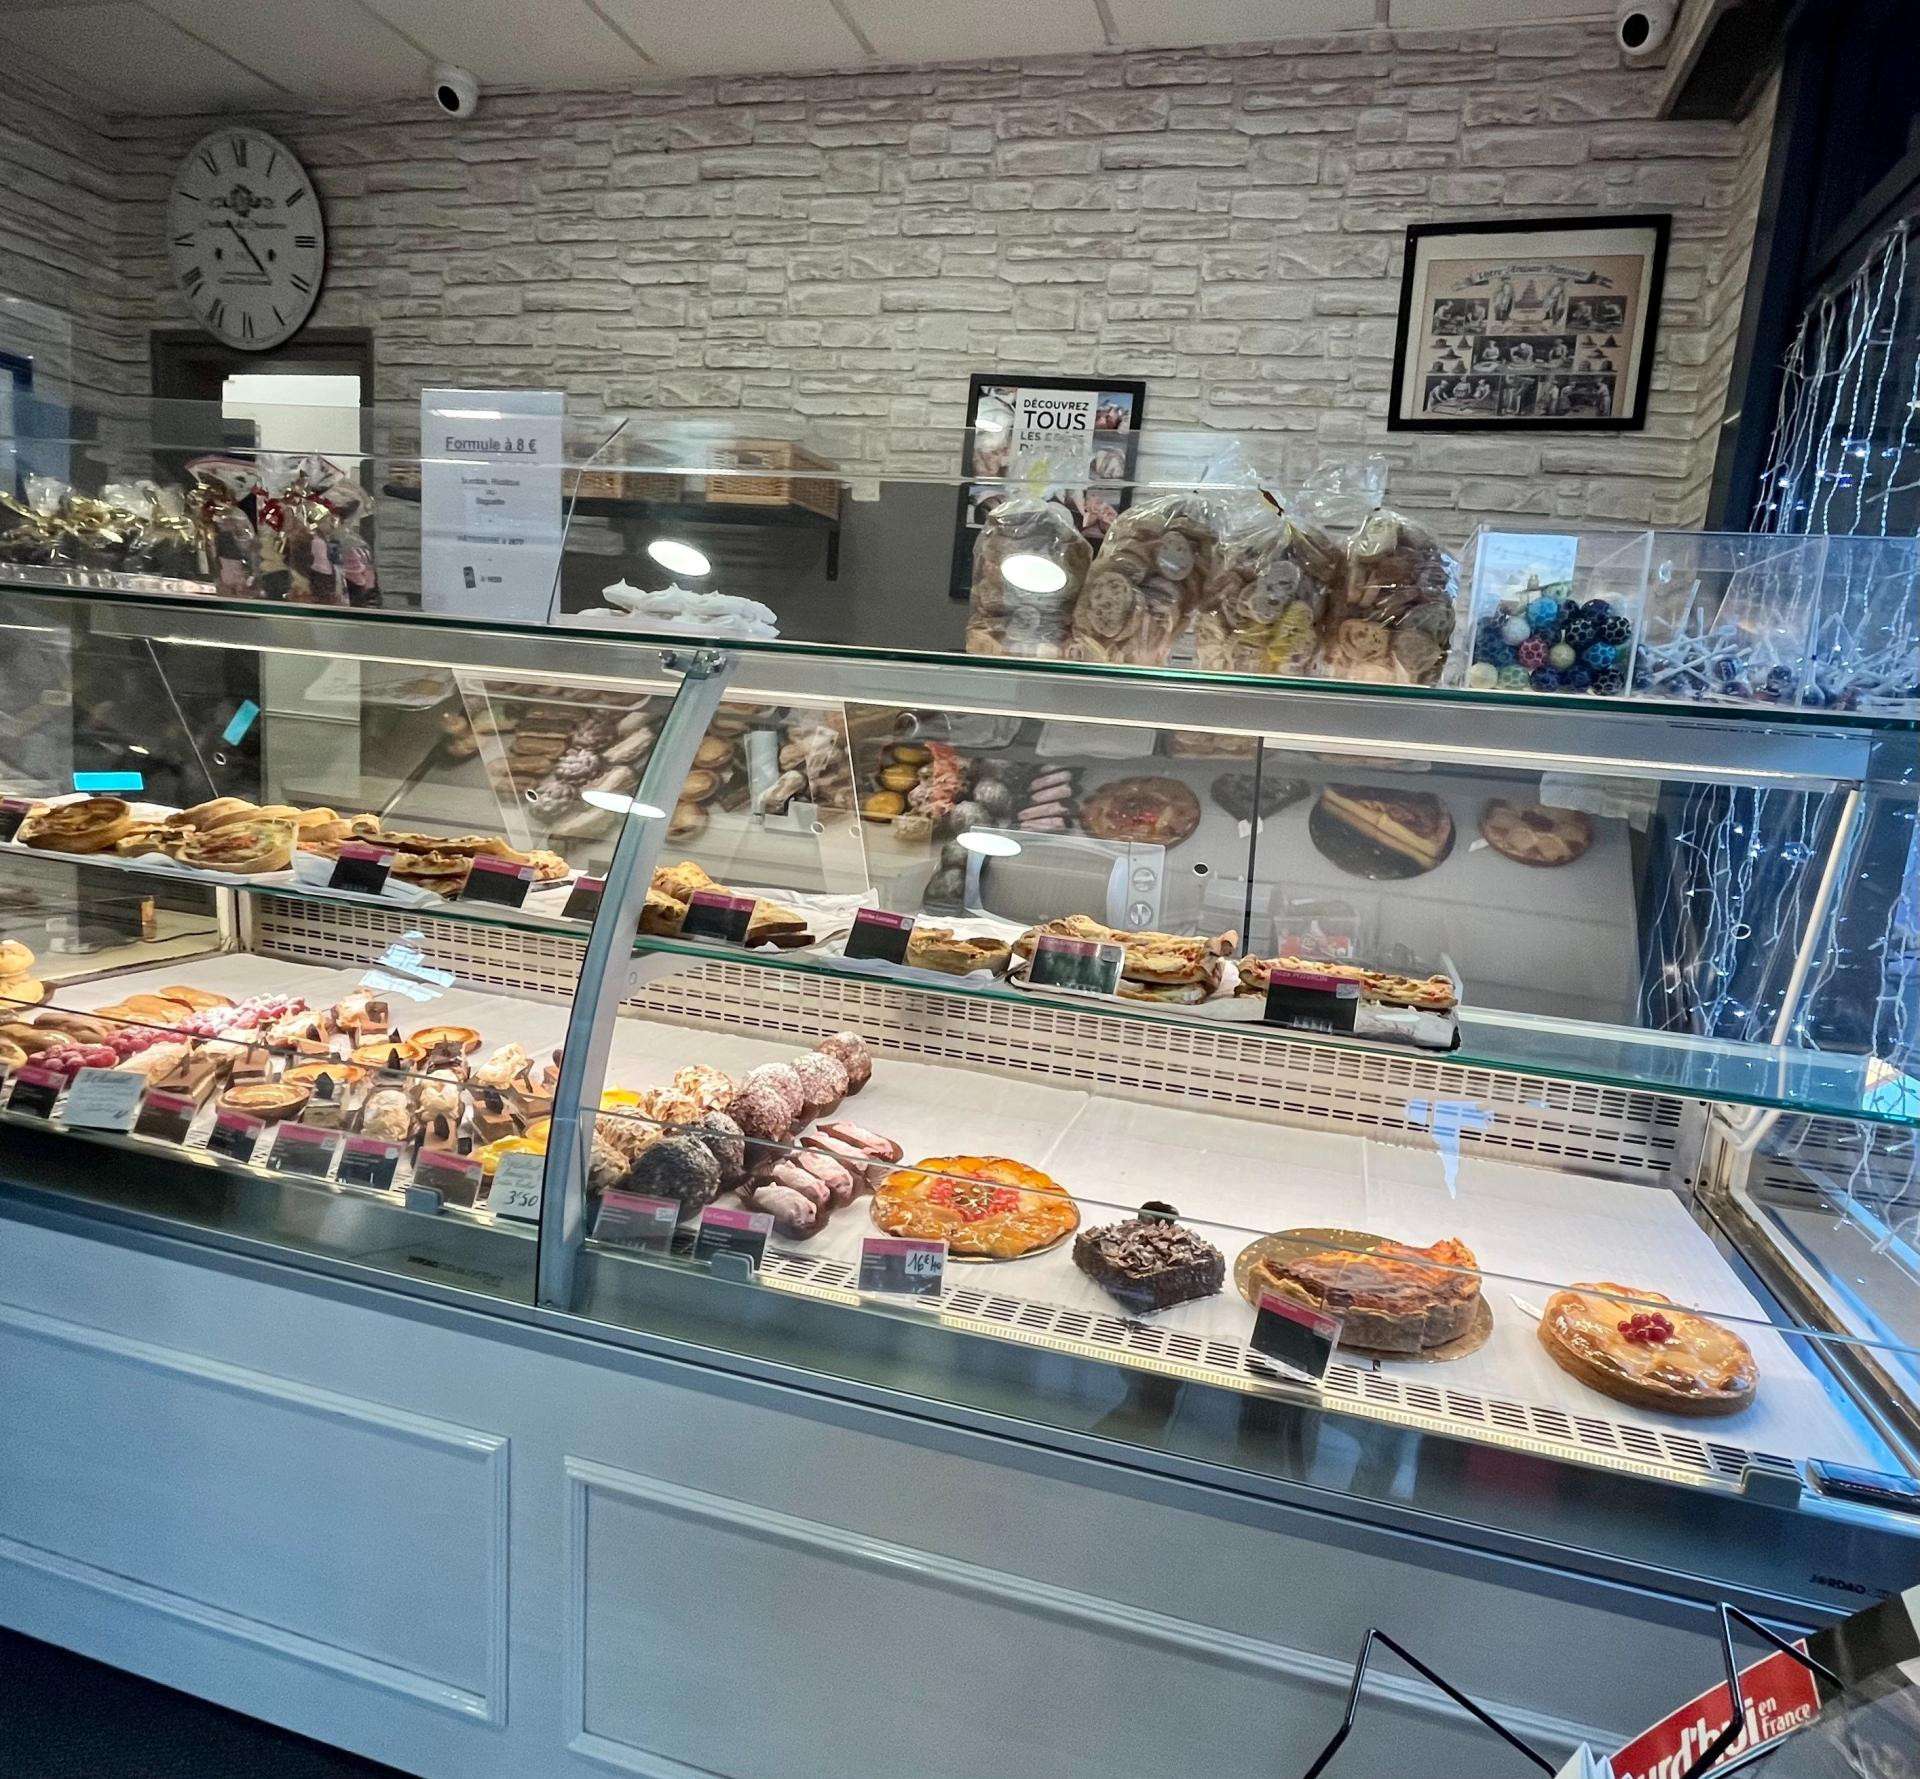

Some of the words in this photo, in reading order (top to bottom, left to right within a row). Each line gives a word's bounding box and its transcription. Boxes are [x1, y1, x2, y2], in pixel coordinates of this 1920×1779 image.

[1024, 398, 1089, 411] DÉCOUVREZ
[1024, 410, 1086, 430] TOUS
[446, 436, 501, 450] Formule
[505, 437, 512, 450] à
[517, 438, 524, 451] 8
[529, 438, 536, 452] €
[1020, 431, 1041, 441] LES
[1758, 1696, 1777, 1717] en
[1762, 1703, 1811, 1739] France
